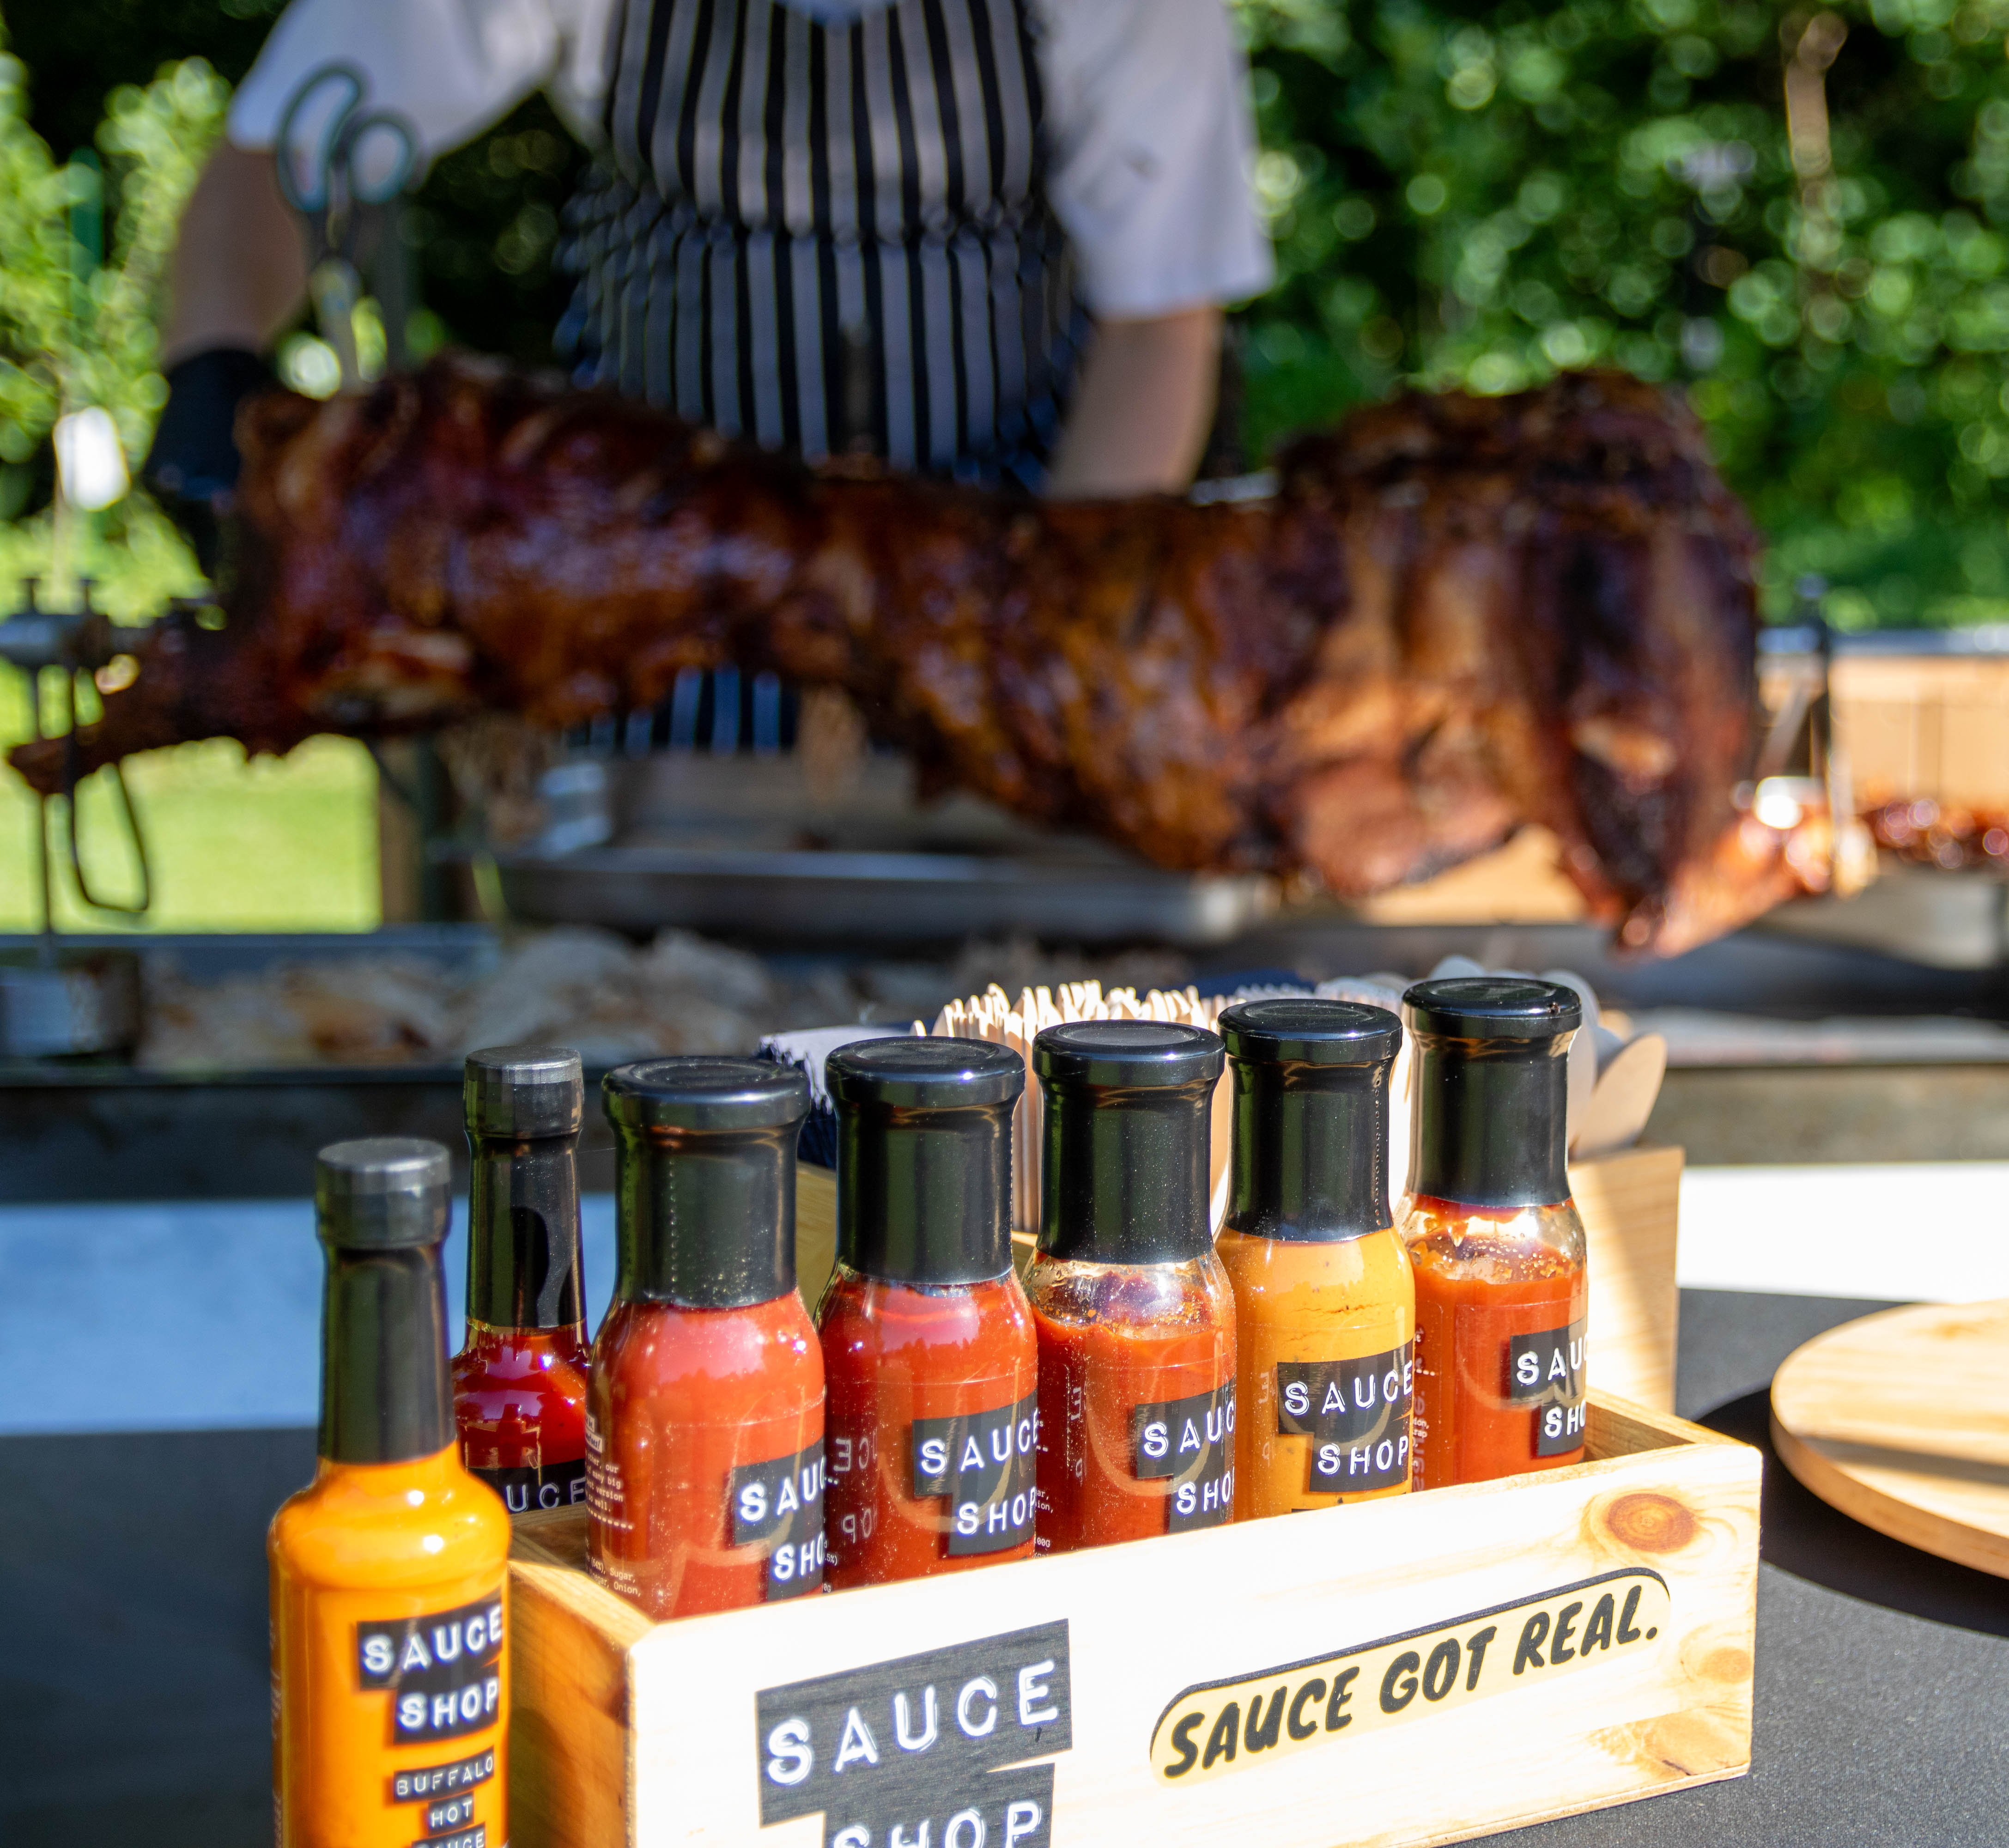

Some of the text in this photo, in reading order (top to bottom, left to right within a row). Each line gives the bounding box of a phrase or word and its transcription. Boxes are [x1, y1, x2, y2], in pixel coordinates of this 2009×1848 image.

[1285, 1360, 1412, 1415] SAUCE
[1144, 1399, 1234, 1457] SAUC
[606, 1464, 619, 1473] our
[1318, 1435, 1408, 1474] SHOP
[506, 1477, 585, 1512] UCE
[593, 1471, 604, 1483] many
[608, 1476, 621, 1489] big
[596, 1486, 623, 1502] version
[1177, 1466, 1235, 1514] SHO
[958, 1486, 1036, 1534] SHOP
[610, 1568, 636, 1583] Sugar,
[775, 1530, 824, 1580] SHO
[613, 1581, 641, 1597] Onion,
[364, 1605, 502, 1672] SAUCE
[399, 1678, 498, 1729] SHOP
[1164, 1585, 1657, 1779] SAUCE GOT REAL.
[767, 1659, 1058, 1785] SAUCE
[396, 1756, 493, 1796] BUFFALO
[431, 1800, 473, 1828] HOT
